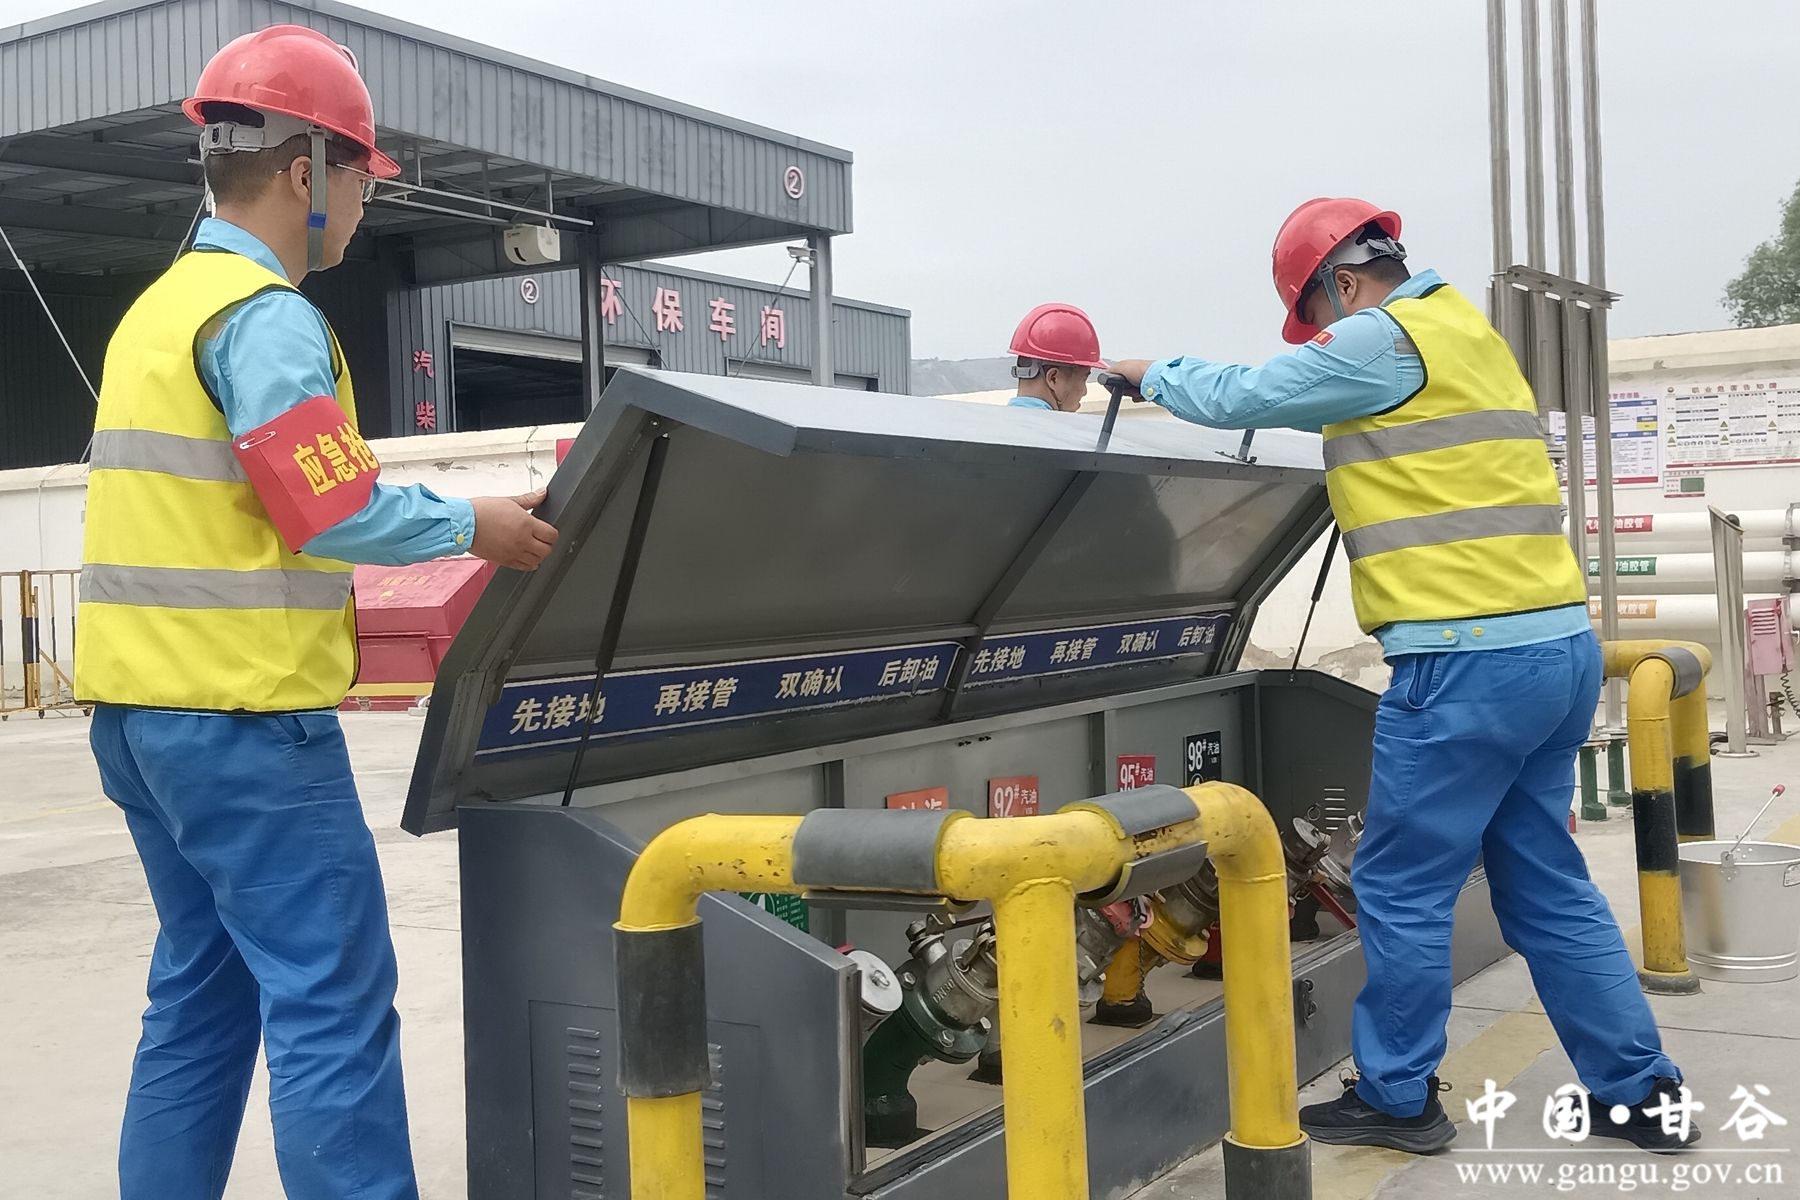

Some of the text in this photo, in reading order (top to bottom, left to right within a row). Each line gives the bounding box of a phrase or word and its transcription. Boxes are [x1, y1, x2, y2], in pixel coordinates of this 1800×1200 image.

[600, 278, 785, 349] 环保车间
[293, 422, 379, 497] 应急抢
[971, 624, 1216, 674] 先接地 再接管 双确认 后卸油
[509, 655, 940, 735] 先接地 再接管 双确认 后卸油
